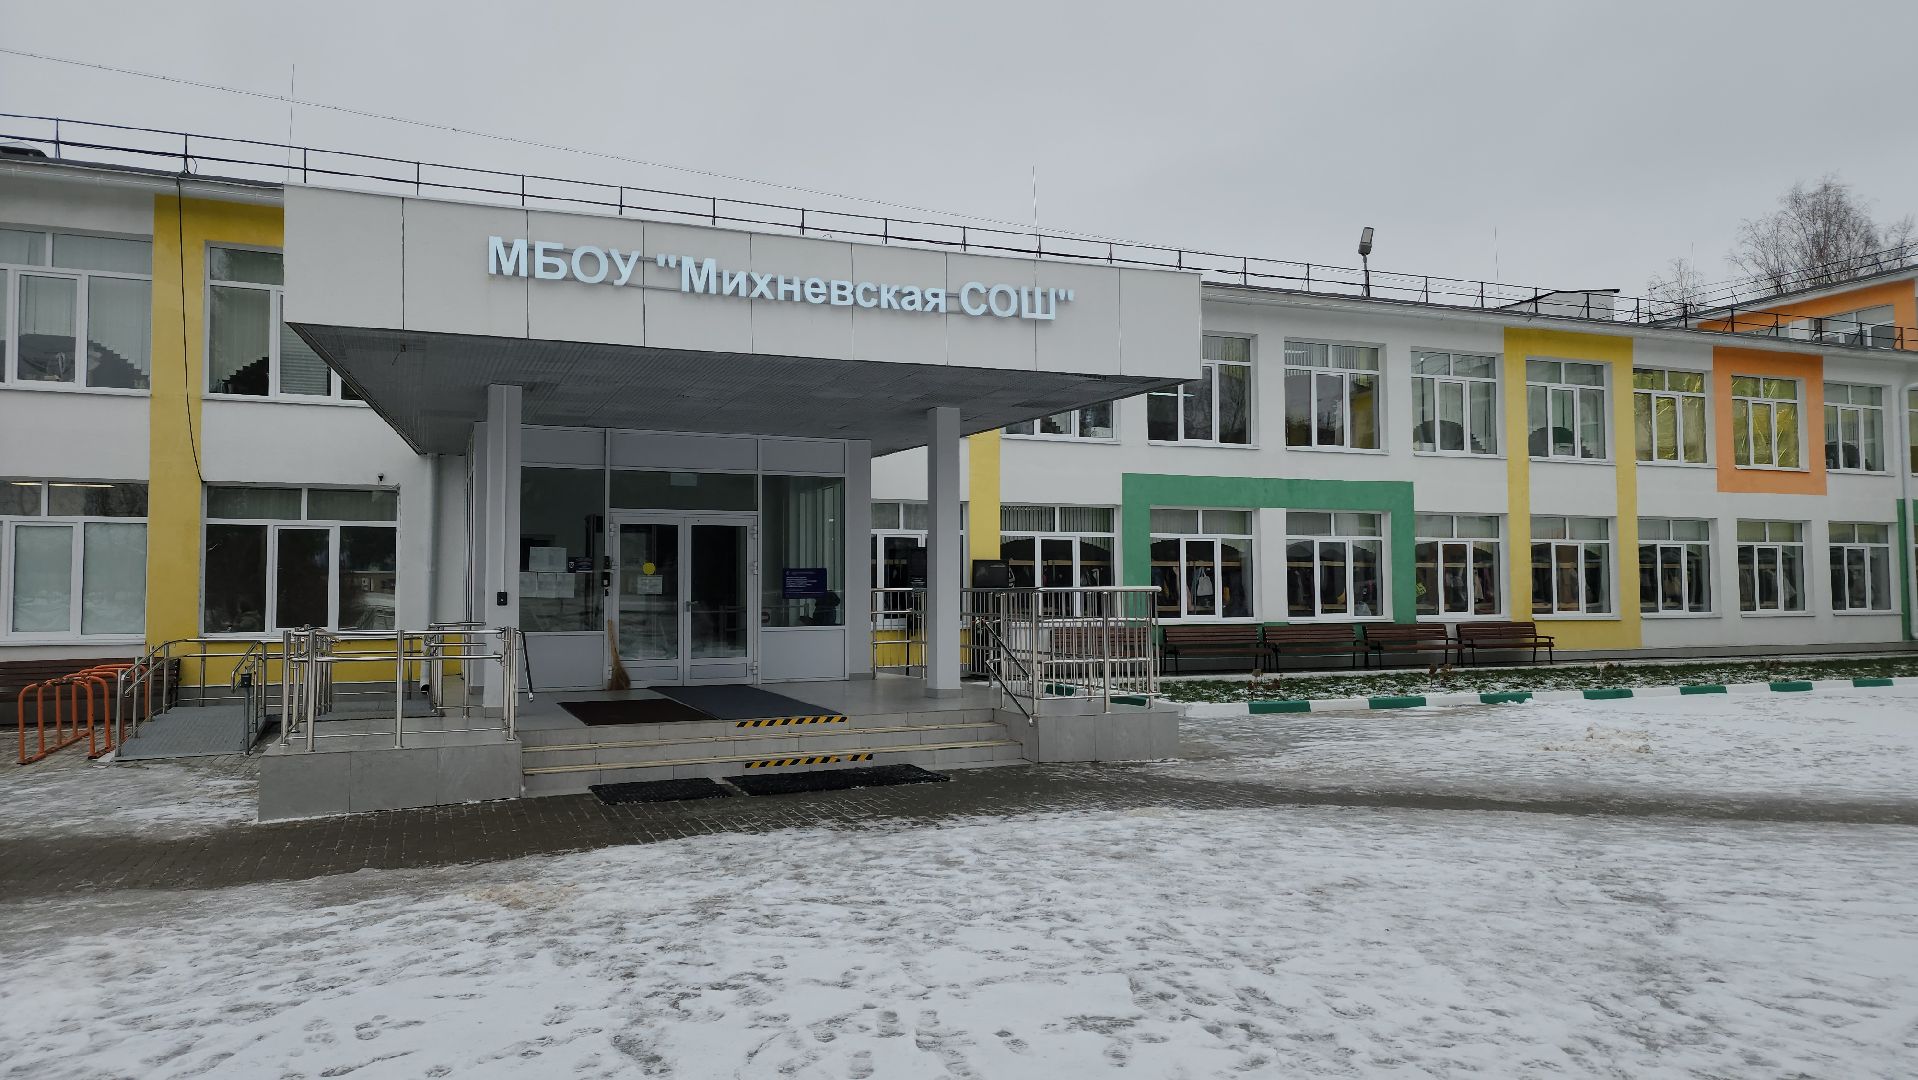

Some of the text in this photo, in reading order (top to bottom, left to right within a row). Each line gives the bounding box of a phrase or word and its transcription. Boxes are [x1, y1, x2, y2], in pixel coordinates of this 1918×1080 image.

[488, 235, 1075, 320] МБОУ "Михневская СОШ"
